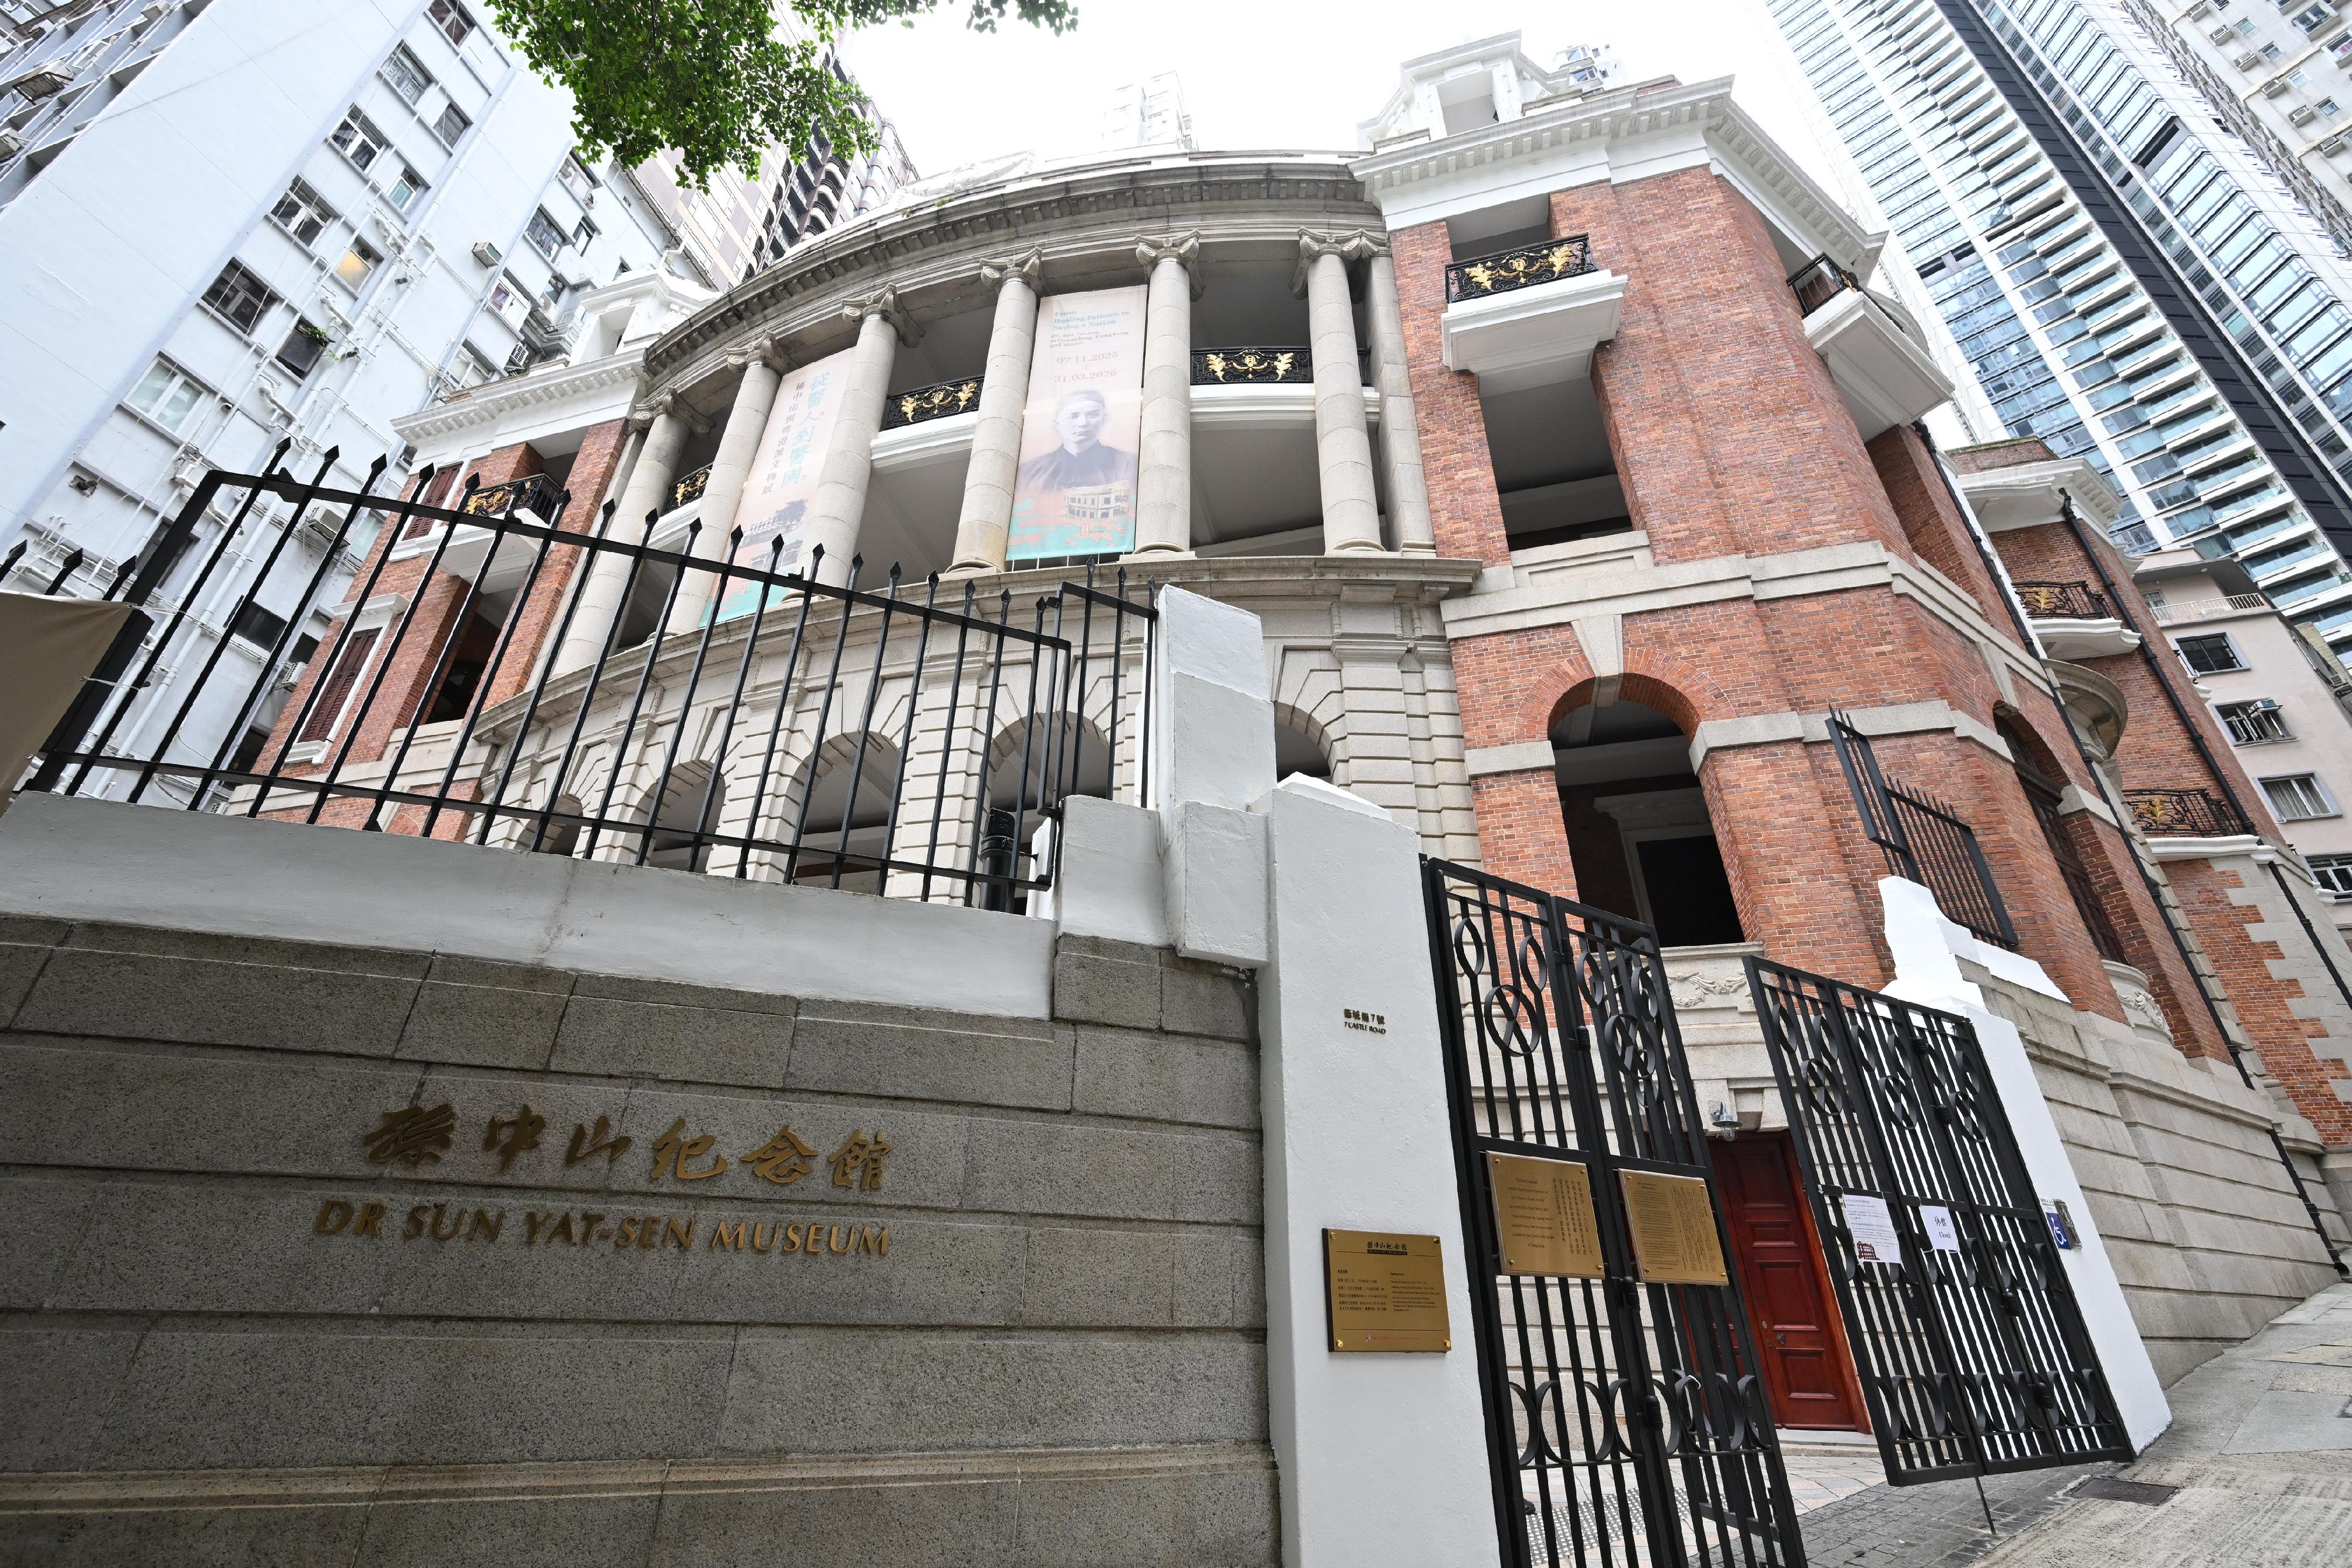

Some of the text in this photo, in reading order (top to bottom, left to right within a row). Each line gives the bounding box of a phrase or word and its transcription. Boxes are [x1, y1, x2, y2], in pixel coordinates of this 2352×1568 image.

[1087, 312, 1120, 320] Patients
[1088, 319, 1116, 327] Nation
[1056, 351, 1119, 364] 07.11.2025
[1054, 369, 1117, 383] 31.03.2026
[1348, 1022, 1368, 1031] CASTLE
[1369, 1025, 1387, 1034] ROAD
[312, 1199, 890, 1257] DR SUN YAT-SEN MUSEUM
